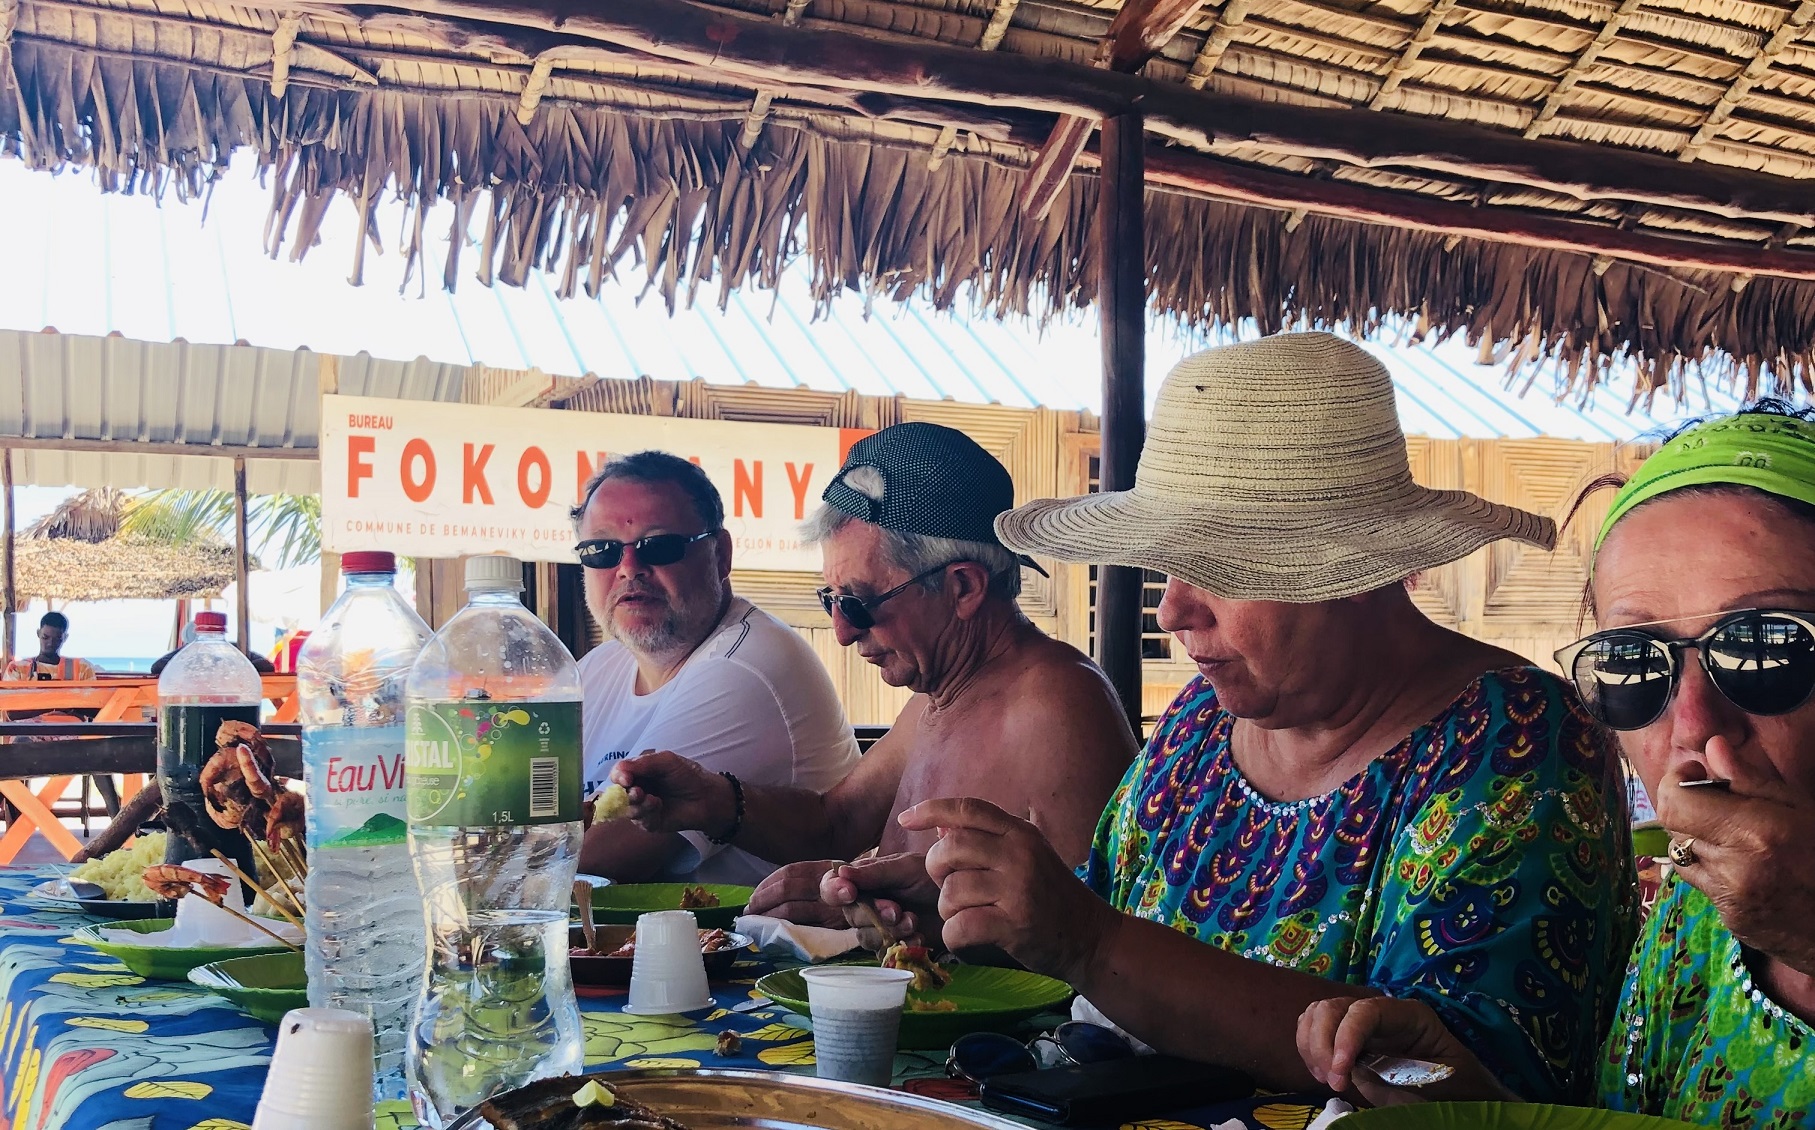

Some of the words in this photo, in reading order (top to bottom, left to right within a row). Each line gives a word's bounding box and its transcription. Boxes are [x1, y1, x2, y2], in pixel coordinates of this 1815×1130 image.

[348, 414, 393, 430] BUREAU
[347, 435, 814, 520] FOKONNY
[346, 519, 412, 535] COMMUNE
[420, 523, 436, 536] DE
[443, 525, 526, 541] BEMANEVIKY
[533, 529, 573, 541] OUEST
[735, 537, 772, 549] EGION
[406, 740, 454, 769] ISTAL
[327, 753, 405, 793] EauVi
[492, 810, 514, 824] 1,5L
